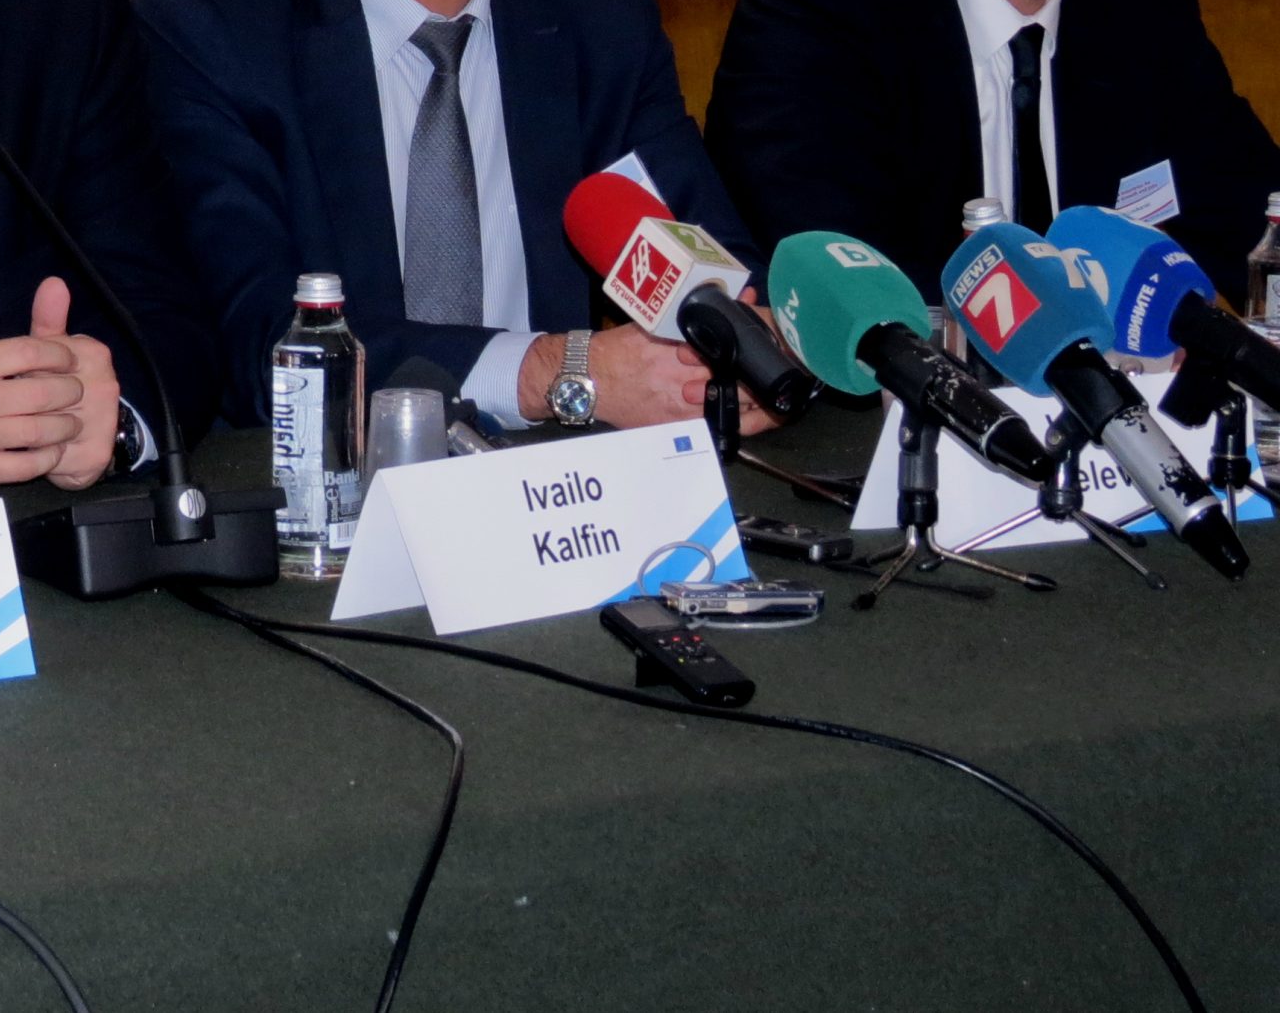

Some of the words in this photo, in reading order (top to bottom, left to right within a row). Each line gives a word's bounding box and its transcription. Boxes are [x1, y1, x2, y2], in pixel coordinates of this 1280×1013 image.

[648, 266, 681, 314] БНТ
[955, 249, 997, 300] NEWS
[610, 278, 654, 324] www.bnt.bg
[967, 272, 1015, 338] 7
[1127, 284, 1156, 352] НОВИНИТЕ
[523, 472, 602, 511] Ivailo
[533, 524, 620, 565] Kalfin
